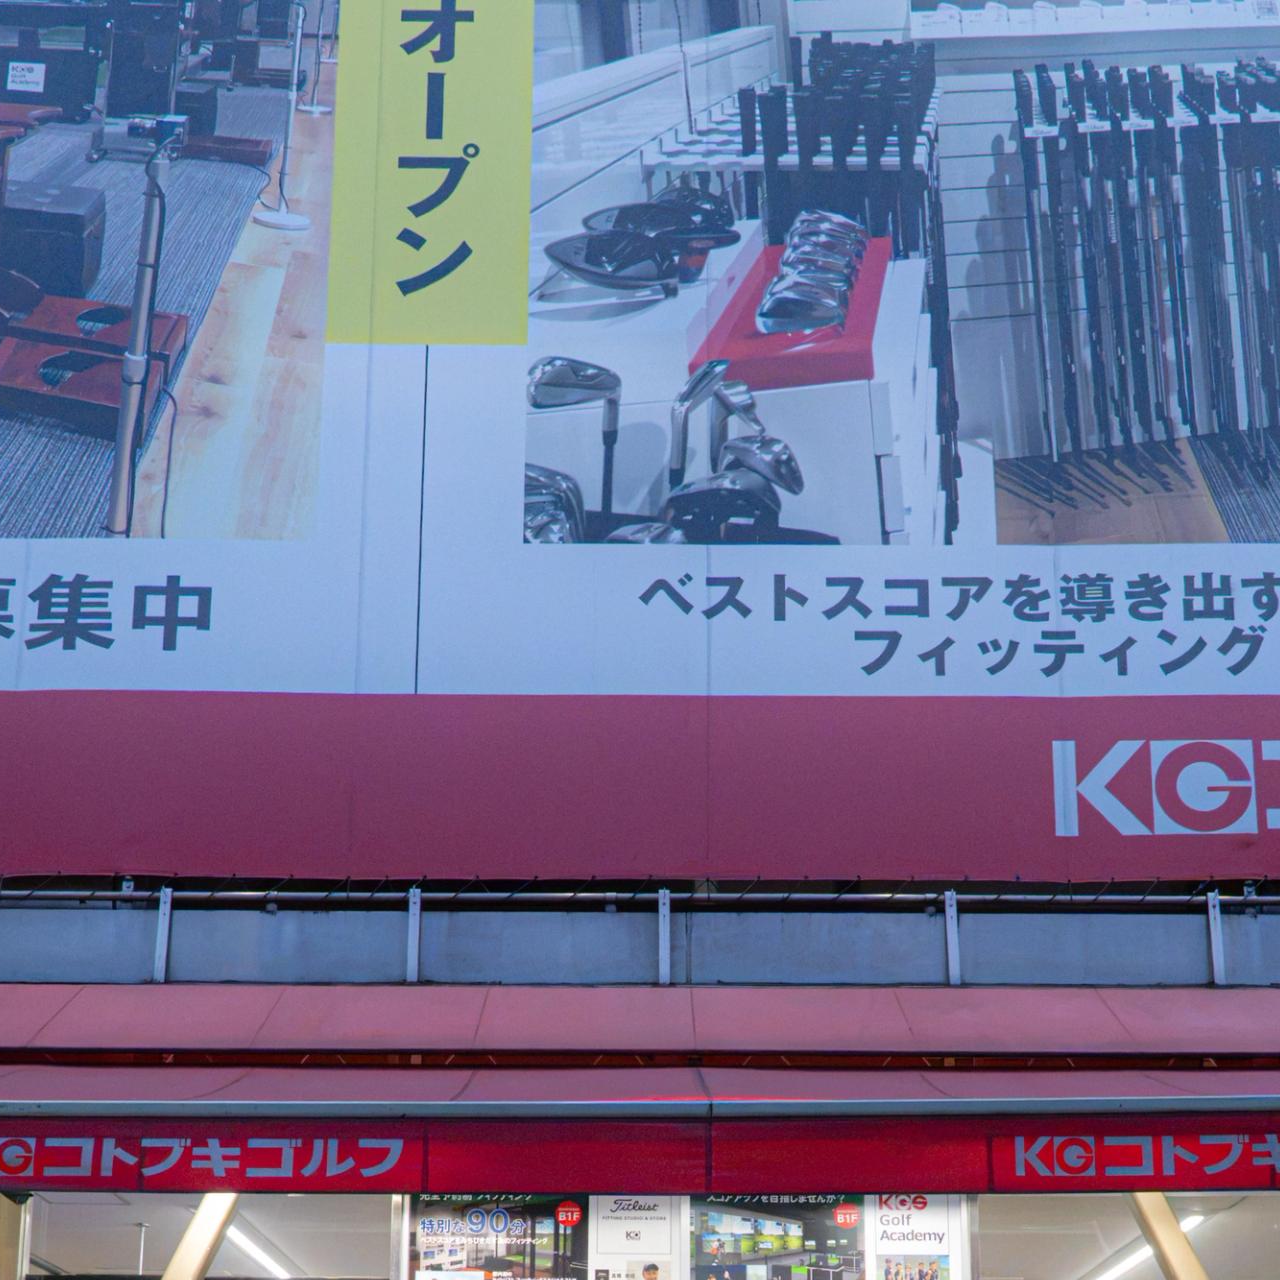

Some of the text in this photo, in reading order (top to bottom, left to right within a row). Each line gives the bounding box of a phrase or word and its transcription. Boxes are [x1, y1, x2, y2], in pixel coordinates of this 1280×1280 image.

[396, 0, 480, 296] オープン
[854, 626, 1269, 678] フィッティング
[610, 1199, 659, 1213] Titleist
[558, 1211, 580, 1221] B1F
[836, 1213, 859, 1223] B1F
[880, 1214, 913, 1227] Golf
[880, 1230, 945, 1244] Academy
